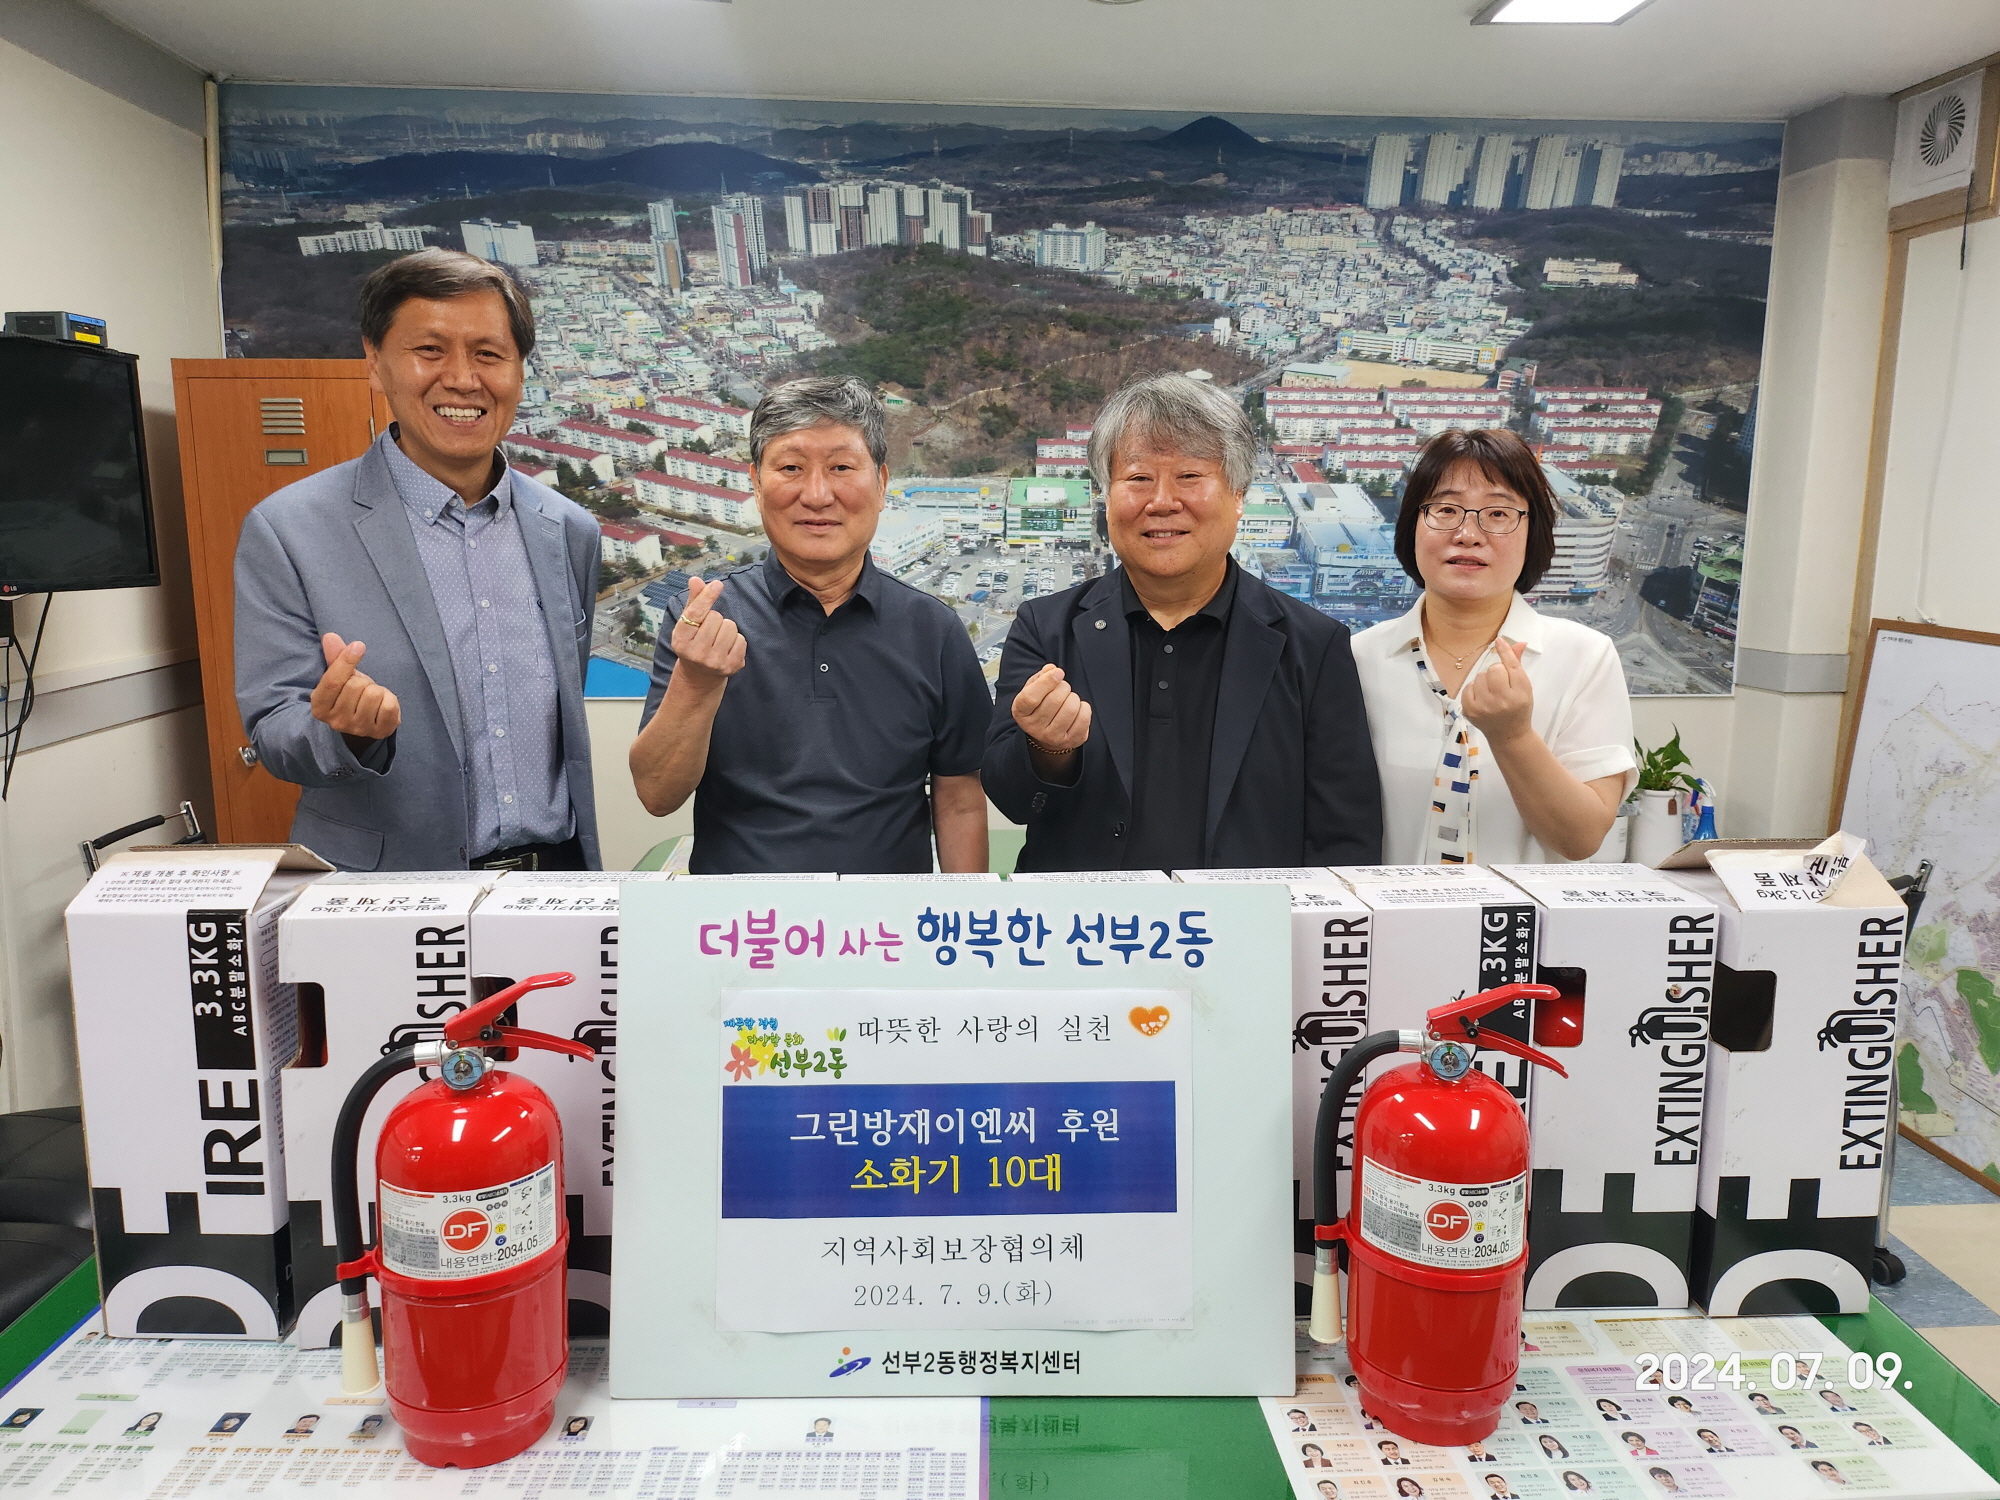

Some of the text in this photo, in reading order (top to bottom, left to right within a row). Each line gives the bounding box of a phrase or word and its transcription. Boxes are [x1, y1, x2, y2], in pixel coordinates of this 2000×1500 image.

[178, 869, 188, 877] 후
[191, 869, 231, 877] 확인사항
[699, 905, 1214, 969] 더불어 사는 행복한 선부2동
[1481, 911, 1509, 994] .3KG
[188, 921, 223, 1018] 3.3KG
[1513, 911, 1532, 1019] AB분말소화기
[747, 1031, 805, 1048] 다양한 문화
[857, 1013, 1112, 1045] 따뜻한 사랑의 실천
[1839, 914, 1905, 1171] EXTINGUISHER
[770, 1047, 848, 1080] 선부2동
[789, 1107, 1121, 1146] 그린방재이엔씨 후원
[849, 1153, 1063, 1195] 소화기 10대
[1428, 1183, 1456, 1196] 3.3kg
[442, 1193, 472, 1204] 3.3kg
[443, 1220, 489, 1240] DF
[1426, 1213, 1470, 1230] DF
[820, 1232, 1086, 1267] 지역사회보장협의체
[853, 1283, 924, 1307] 2024.
[939, 1283, 962, 1306] 7.
[881, 1348, 1082, 1376] 선부2동행정복지센터
